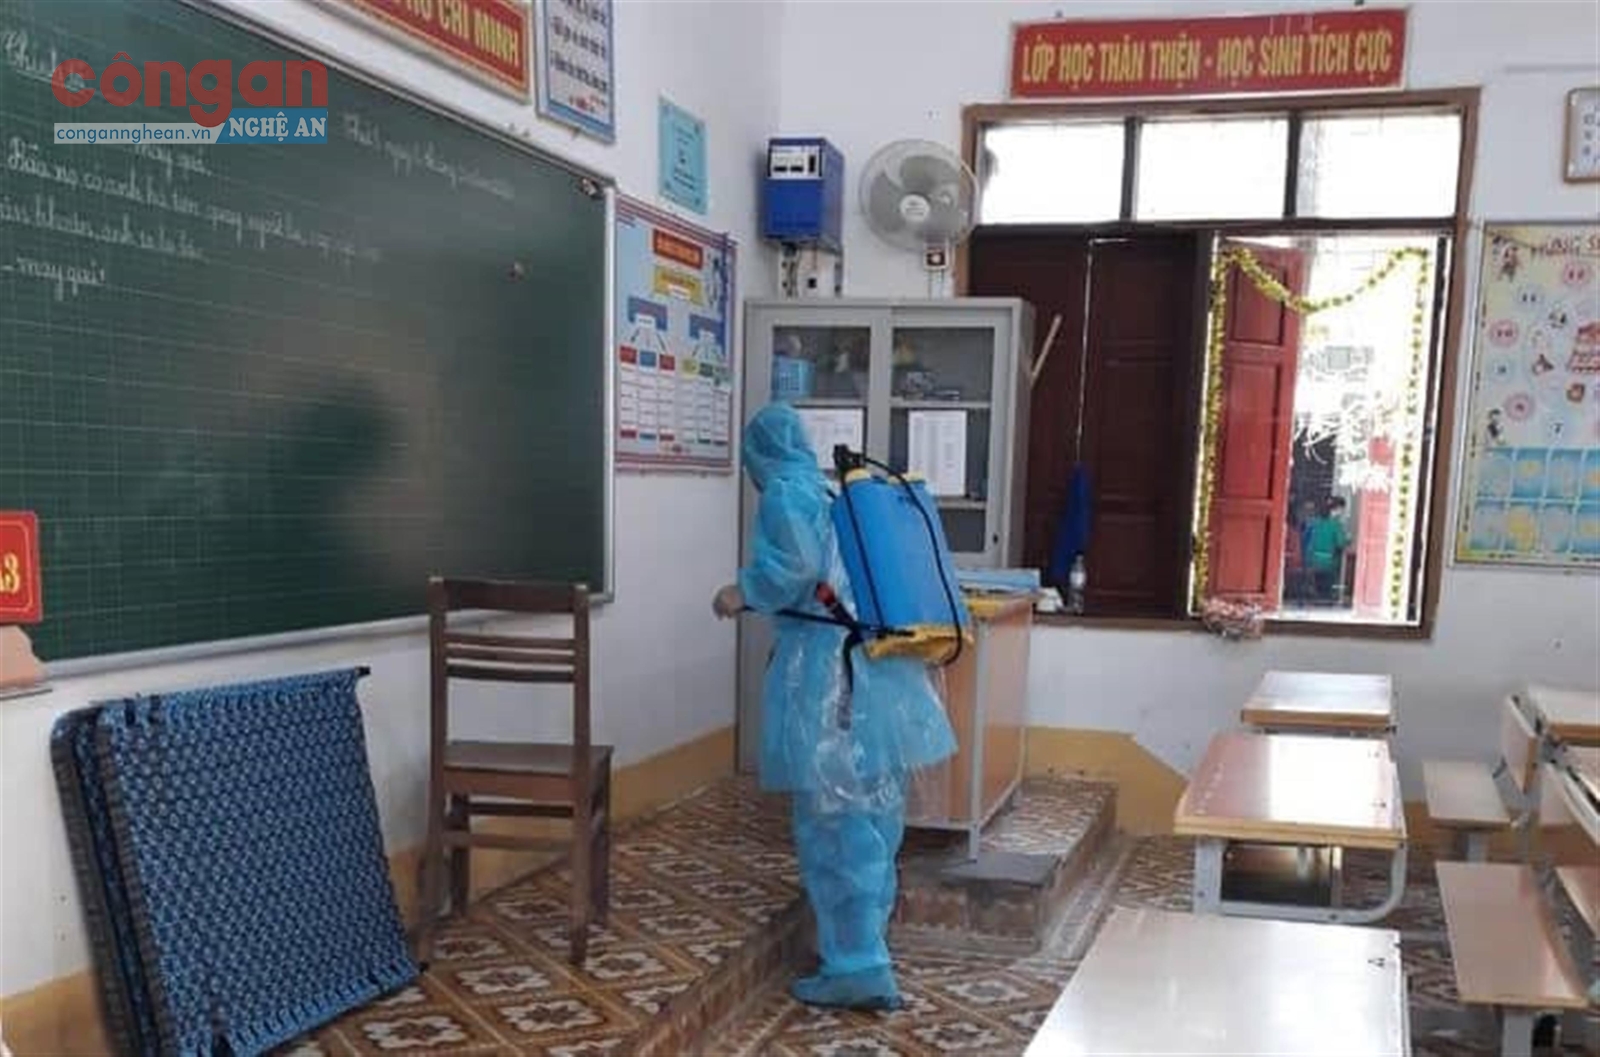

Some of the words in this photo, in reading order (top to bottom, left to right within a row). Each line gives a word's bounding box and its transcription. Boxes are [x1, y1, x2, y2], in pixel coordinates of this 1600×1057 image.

[474, 8, 519, 67] MINH
[1022, 34, 1055, 83] LỚP
[1059, 42, 1095, 90] HỌC
[1150, 32, 1202, 88] THIỆN
[1217, 36, 1254, 87] HỌC
[1259, 34, 1304, 77] SINH
[1309, 24, 1350, 75] TÍCH
[1354, 27, 1393, 82] CỰC
